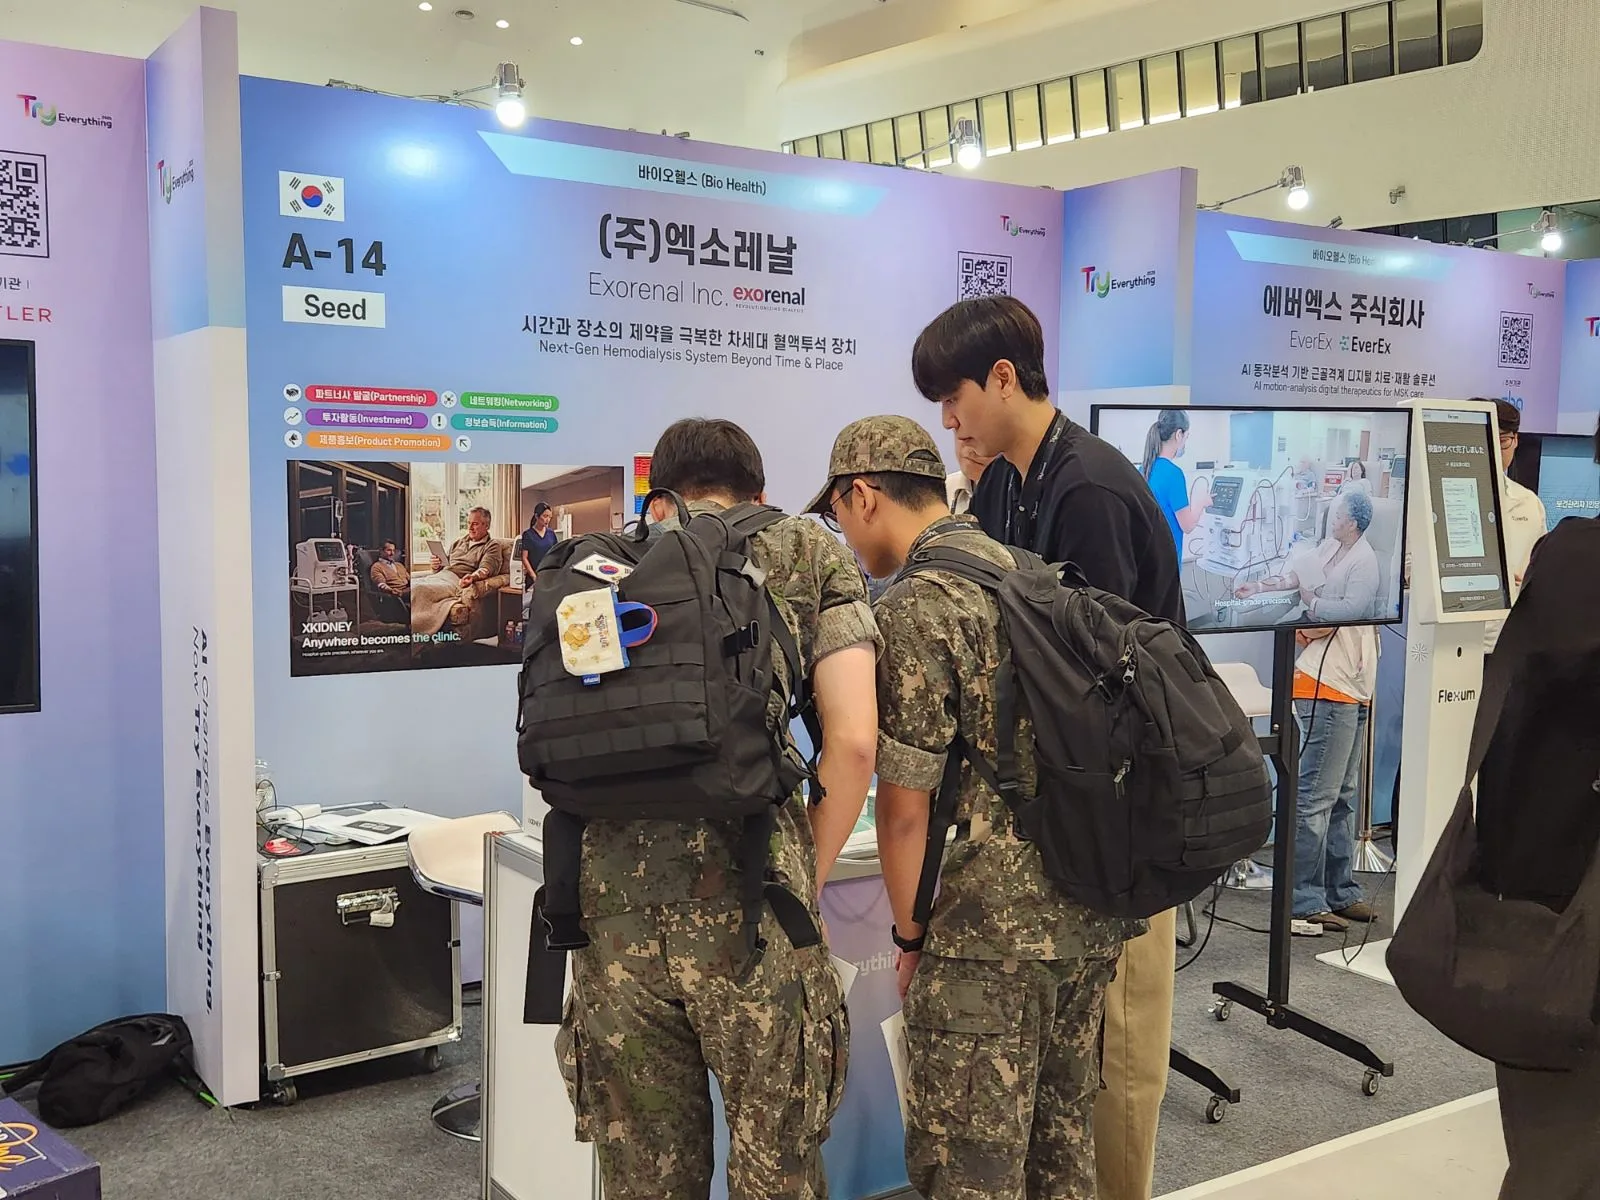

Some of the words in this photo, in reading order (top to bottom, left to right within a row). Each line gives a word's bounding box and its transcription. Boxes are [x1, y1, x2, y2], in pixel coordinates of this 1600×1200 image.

[16, 93, 57, 126] Try
[58, 112, 112, 129] Everything
[638, 164, 698, 186] 바이오헬스
[701, 173, 723, 189] (Bio
[726, 177, 767, 196] Health)
[282, 232, 387, 276] A-14
[599, 213, 797, 275] (주)엑소레날
[589, 271, 684, 303] Exorenal
[692, 281, 729, 307] Inc.
[1081, 265, 1110, 298] Try
[1111, 275, 1156, 290] Everything
[304, 294, 367, 320] Seed
[733, 285, 805, 306] exorenal
[1263, 285, 1342, 321] 에버엑스
[1350, 293, 1425, 329] 주식회사
[0, 305, 52, 322] LER
[522, 315, 571, 336] 시간과
[577, 319, 623, 340] 장소의
[629, 322, 674, 344] 제약을
[679, 326, 723, 347] 극복한
[728, 330, 768, 350] 차세대
[774, 333, 827, 354] 혈액투석
[831, 338, 857, 355] 장치
[1290, 330, 1333, 350] EverEx
[1352, 336, 1391, 354] EverEx
[539, 340, 599, 356] Next-Gen
[603, 344, 682, 363] Hemodialysis
[685, 350, 728, 364] System
[731, 352, 772, 368] Beyond
[775, 355, 801, 368] Time
[804, 357, 812, 369] &
[815, 358, 844, 371] Place
[1241, 363, 1251, 375] AI
[1254, 363, 1289, 378] 동작분석
[1292, 365, 1309, 380] 기반
[1311, 367, 1345, 381] 근골격계
[1348, 369, 1372, 383] 디지털
[1413, 373, 1436, 387] 솔루션
[315, 388, 351, 400] 파트너사
[1254, 380, 1261, 390] AI
[1263, 381, 1317, 394] motion-analysis
[1319, 383, 1339, 396] digital
[1341, 385, 1381, 397] therapeutics
[1384, 387, 1392, 396] for
[1410, 390, 1424, 398] care
[322, 412, 413, 425] 투자활동(Investment)
[394, 437, 441, 448] Promotion)
[302, 621, 352, 634] XKIDNEY
[302, 635, 359, 649] Anywhere
[360, 634, 411, 646] becomes
[412, 632, 430, 643] the
[431, 631, 461, 644] clinic.
[192, 625, 200, 696] Now
[1438, 689, 1476, 703] Flexum
[193, 703, 201, 760] Try
[195, 769, 204, 951] Everything
